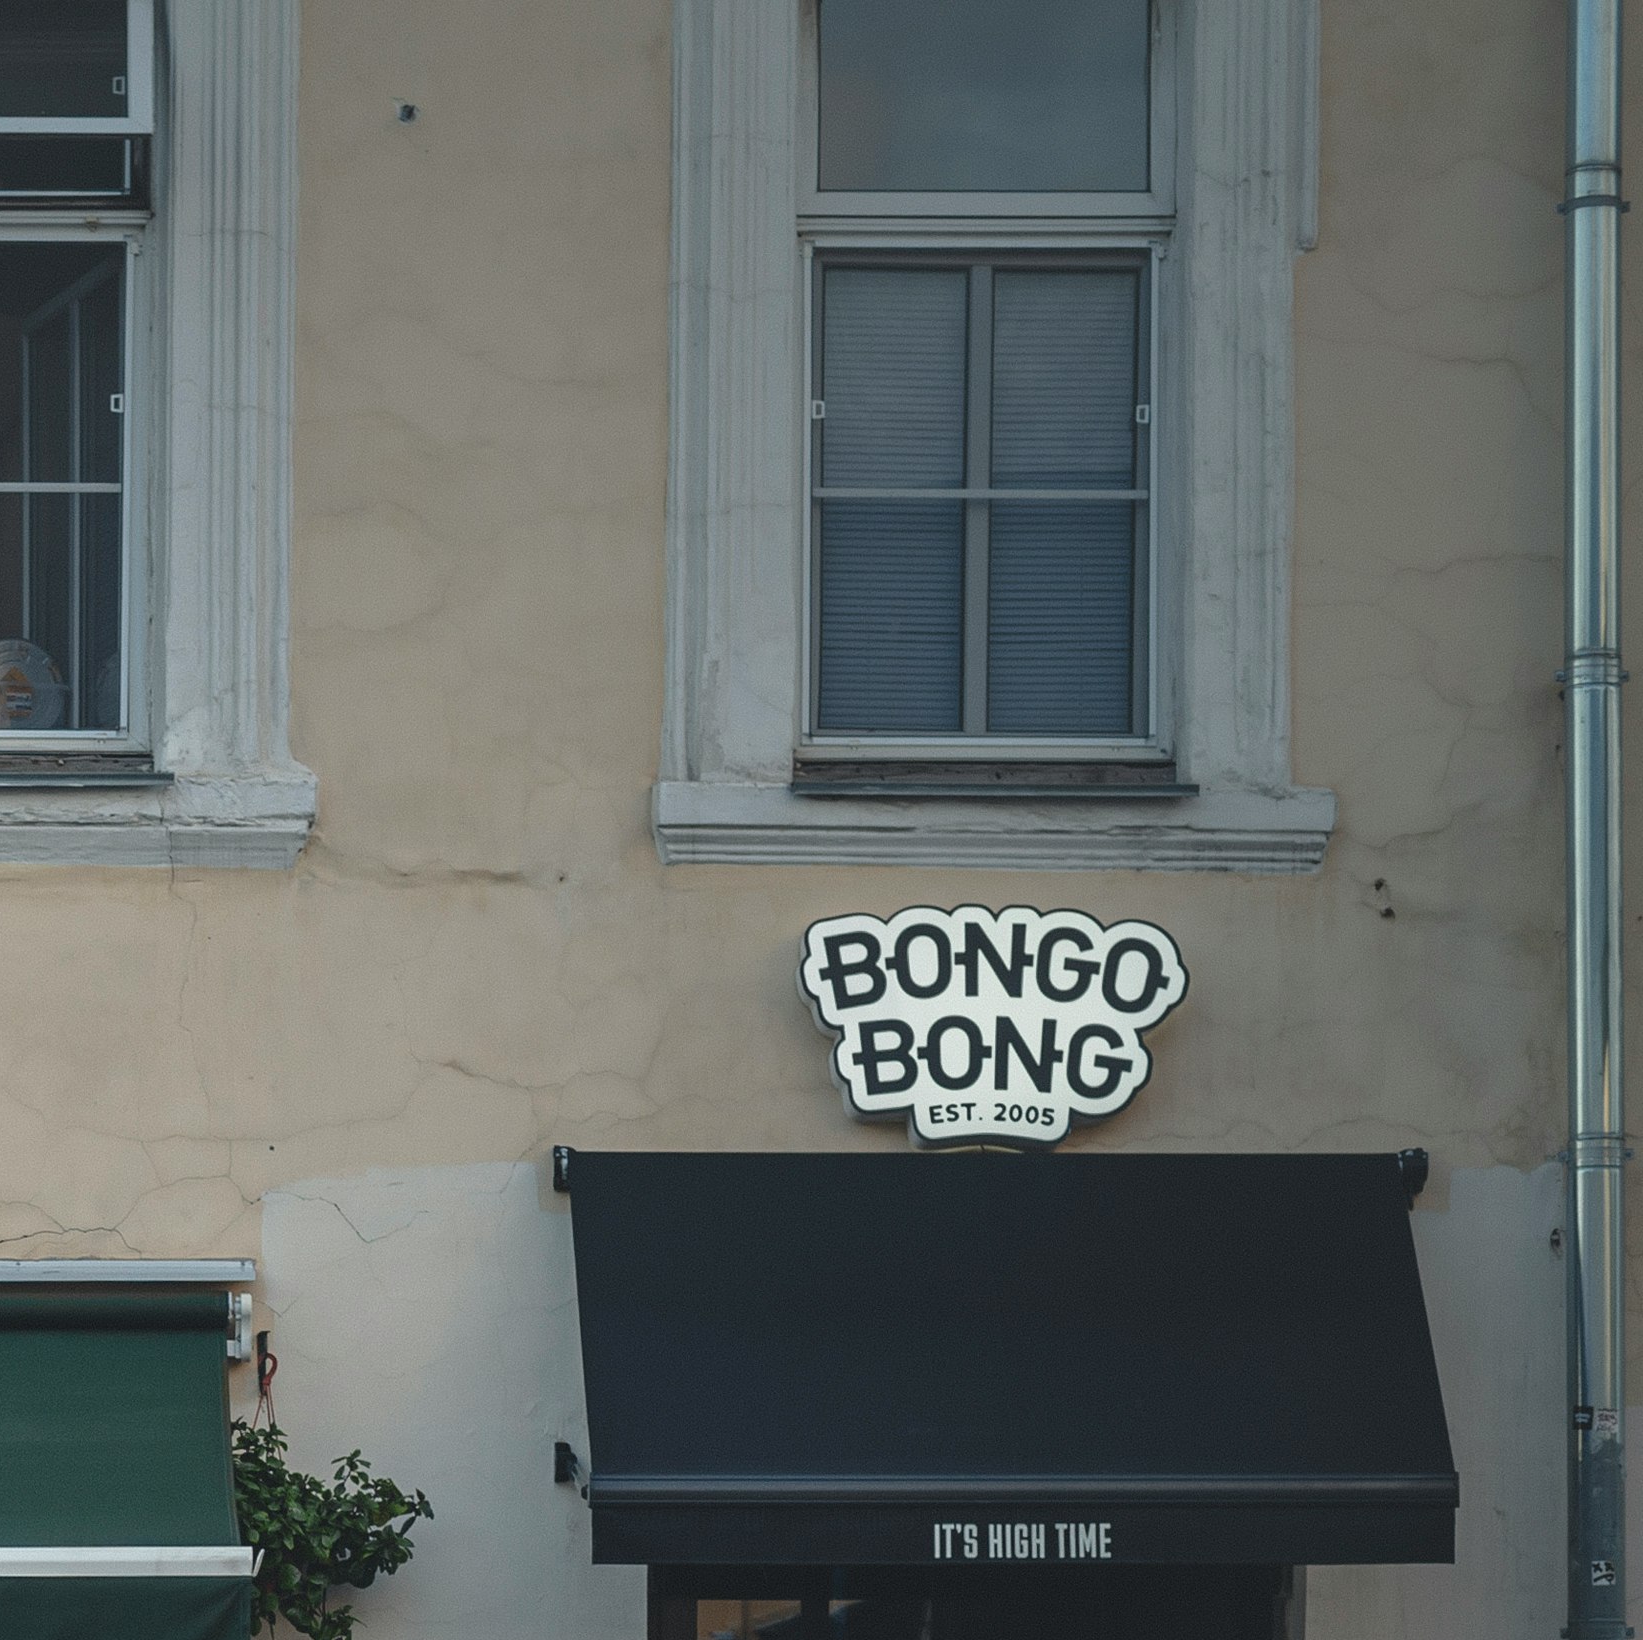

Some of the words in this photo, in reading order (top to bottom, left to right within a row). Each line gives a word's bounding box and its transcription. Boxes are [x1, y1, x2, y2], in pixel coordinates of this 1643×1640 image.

[819, 921, 1170, 1014] BONGO
[852, 1015, 1133, 1099] BONG
[929, 1102, 983, 1124] EST.
[994, 1104, 1055, 1126] 2005
[934, 1523, 978, 1559] IT'S
[988, 1523, 1045, 1559] HIGH
[1055, 1523, 1112, 1559] TIME
